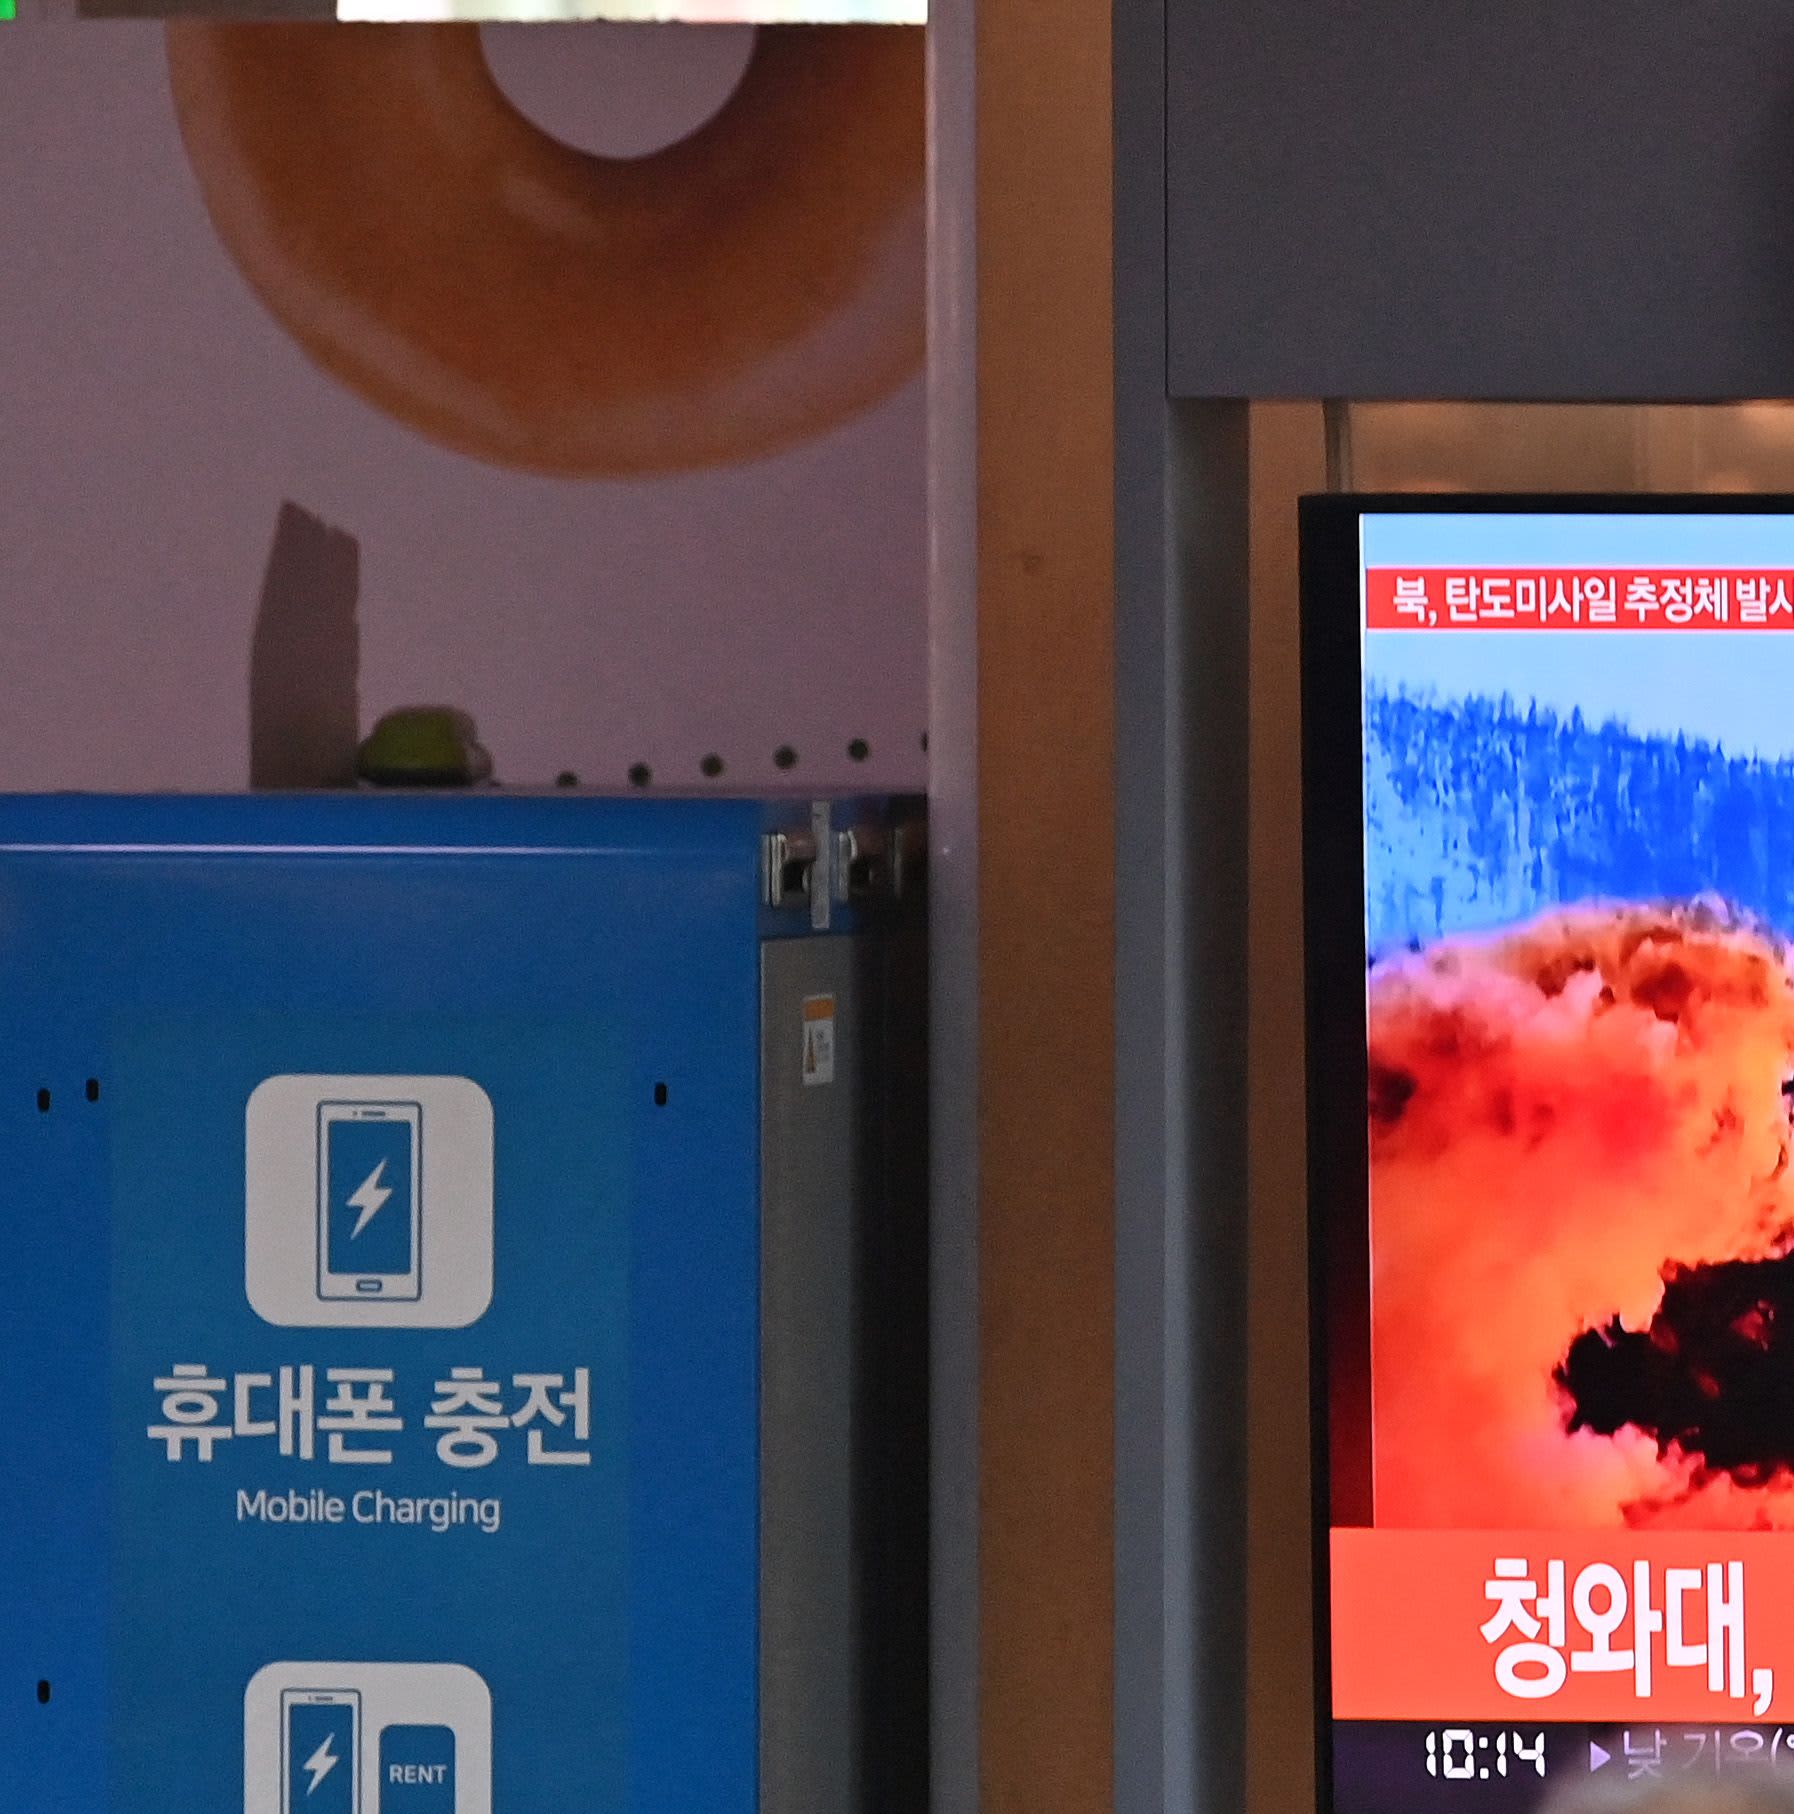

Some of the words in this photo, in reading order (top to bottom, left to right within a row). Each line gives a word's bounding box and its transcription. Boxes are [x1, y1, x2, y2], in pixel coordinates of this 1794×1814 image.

[1392, 576, 1438, 627] 북,
[1445, 576, 1617, 624] 탄도미사일
[1623, 577, 1728, 623] 추정체
[146, 1363, 403, 1465] 휴대폰
[423, 1366, 592, 1468] 충전
[236, 1488, 345, 1523] Mobile
[351, 1489, 501, 1533] Charging
[1479, 1558, 1775, 1717] 청와대,
[389, 1764, 448, 1785] RENT
[1425, 1728, 1546, 1780] 10:14
